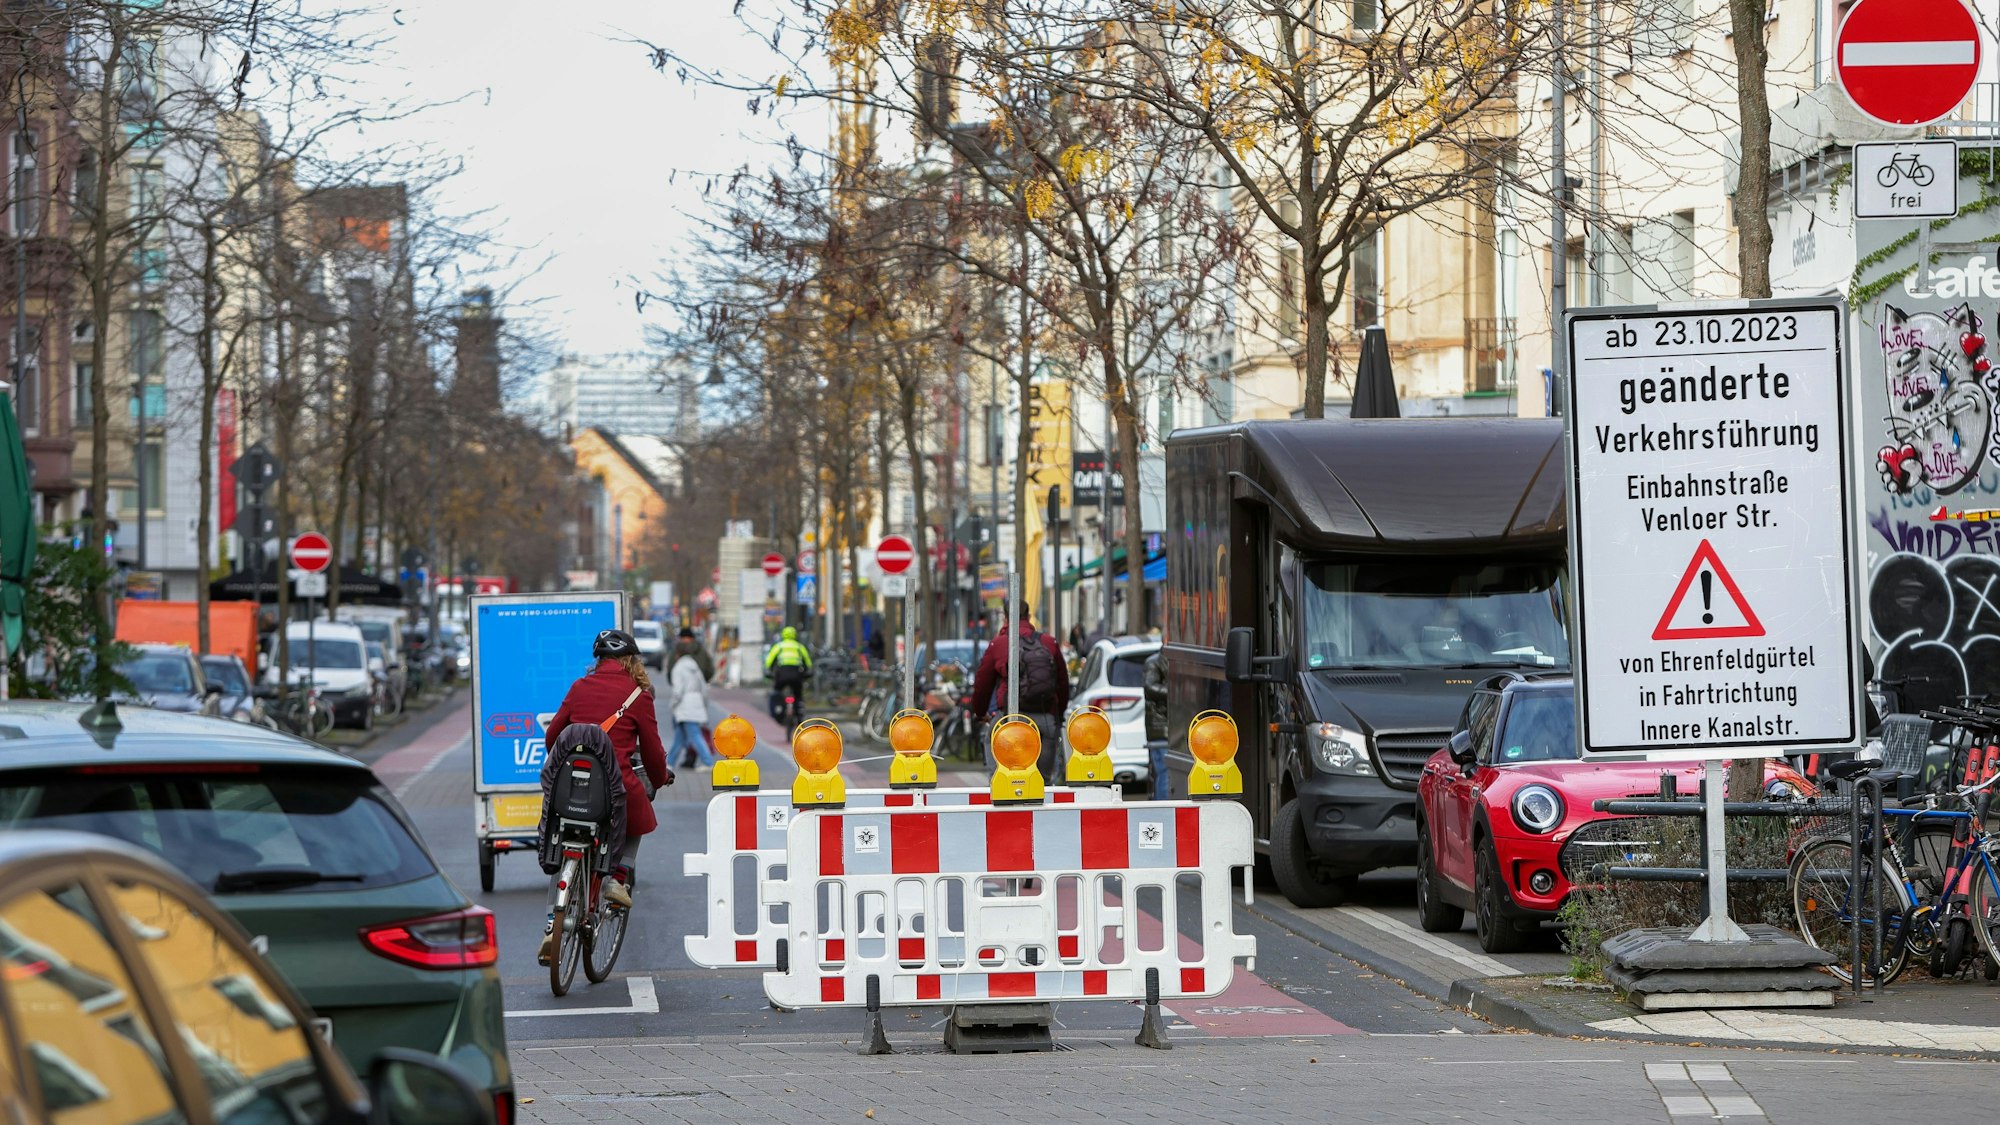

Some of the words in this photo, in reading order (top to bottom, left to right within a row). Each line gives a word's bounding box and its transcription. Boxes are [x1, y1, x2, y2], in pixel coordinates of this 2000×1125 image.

[1891, 192, 1922, 208] frei
[1606, 323, 1638, 347] ab
[1654, 315, 1798, 346] 23.10.2023
[1619, 363, 1790, 415] geänderte
[1595, 420, 1819, 453] Verkehrsführung
[1627, 469, 1789, 500] Einbahnstraße
[1641, 506, 1728, 532] Venloer
[1736, 503, 1778, 528] Str.
[1619, 657, 1654, 674] von
[1661, 645, 1816, 675] Ehrenfeldgürtel
[1639, 686, 1656, 707] in
[1663, 682, 1798, 707] Fahrtrichtung
[1641, 718, 1701, 741] Innere
[1708, 715, 1799, 738] Kanalstr.
